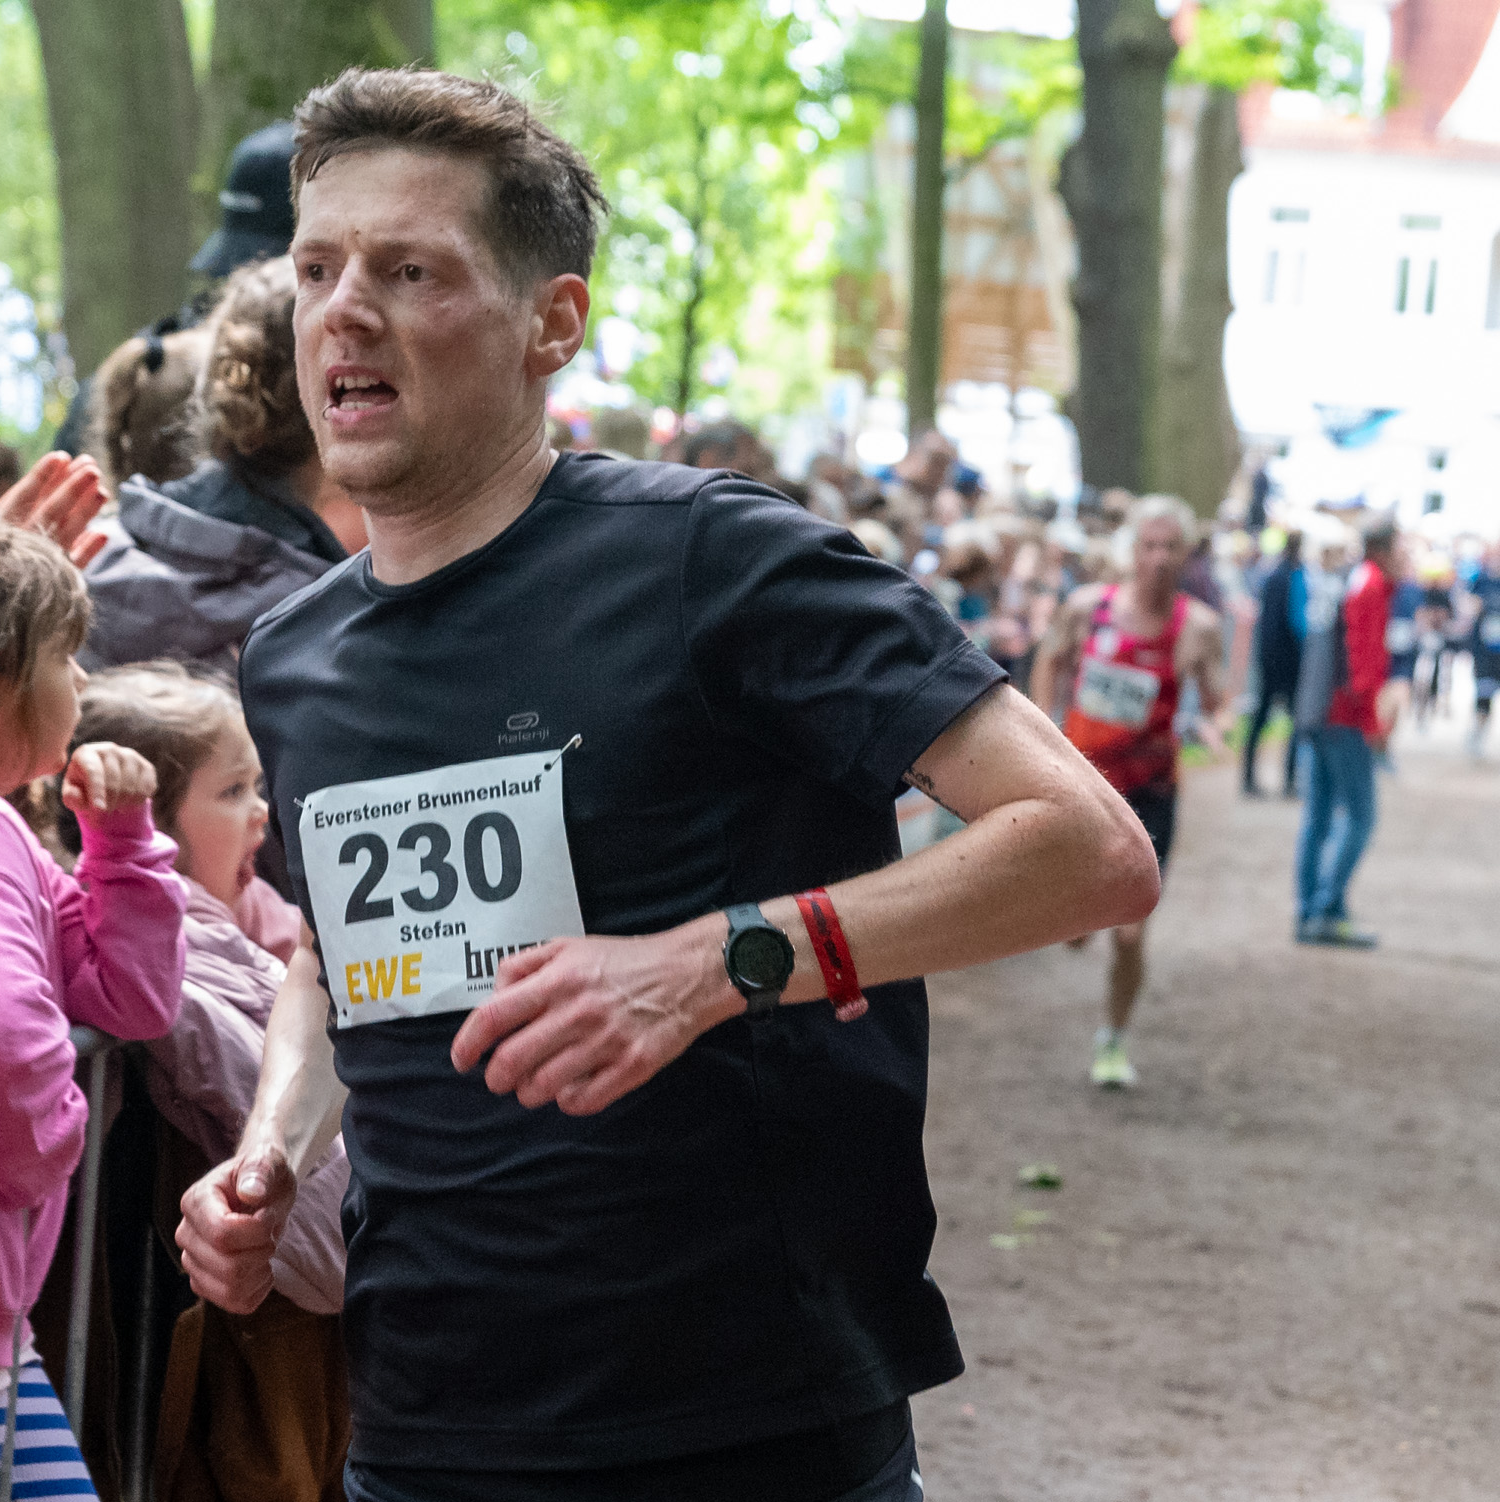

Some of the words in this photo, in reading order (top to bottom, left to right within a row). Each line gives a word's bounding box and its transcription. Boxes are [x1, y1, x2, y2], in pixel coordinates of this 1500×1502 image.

[314, 797, 412, 830] Everstener
[417, 774, 543, 811] Brunnenlauf
[338, 811, 523, 926] 230
[400, 920, 467, 943] Stefan
[345, 952, 422, 1005] EWE
